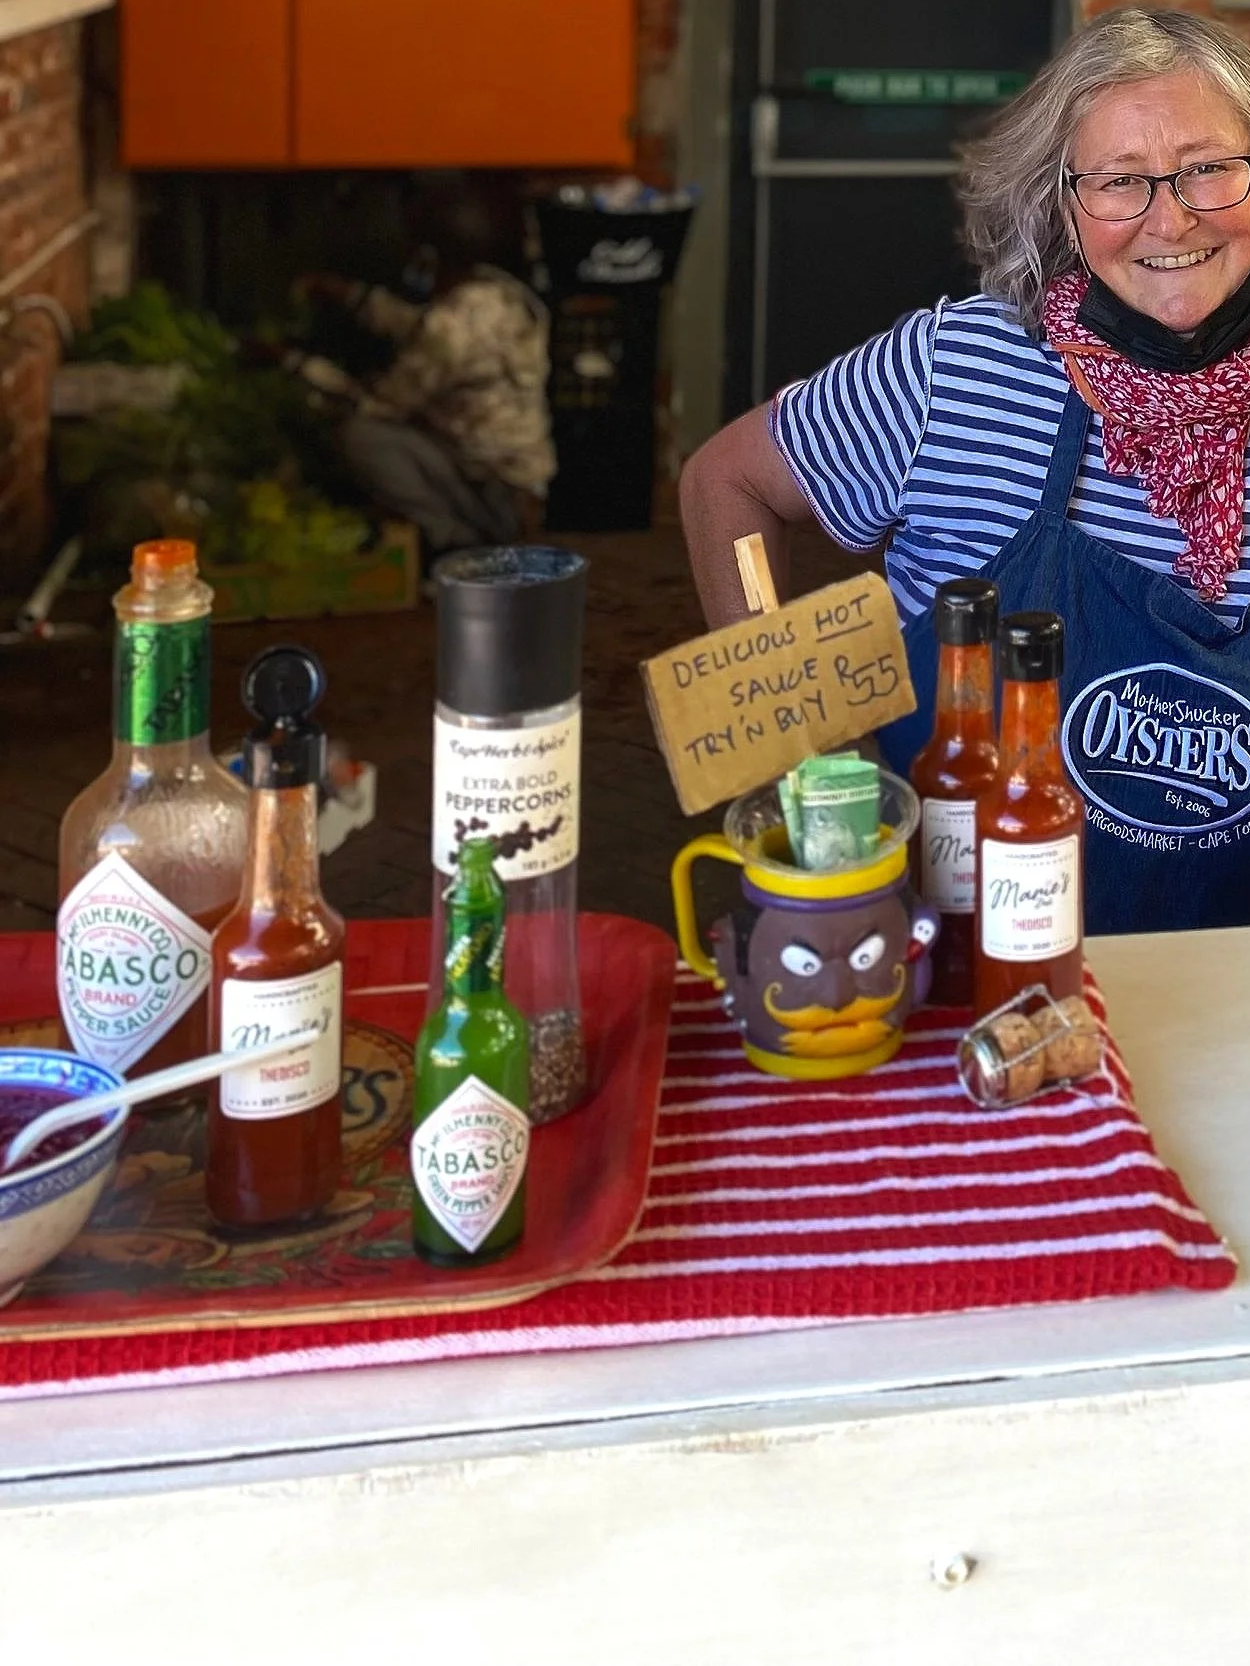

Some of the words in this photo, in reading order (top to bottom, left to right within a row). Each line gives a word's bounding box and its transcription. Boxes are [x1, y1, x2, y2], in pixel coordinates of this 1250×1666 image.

[672, 622, 796, 688] DELICIOUS
[815, 593, 870, 633] HOT
[730, 657, 818, 707] SAUCE
[834, 653, 899, 706] R55
[686, 725, 736, 765] TRY
[774, 690, 827, 733] BUY
[463, 776, 513, 792] EXTRA
[516, 770, 558, 791] BOLD
[446, 784, 572, 814] PEPPERCORNS
[1165, 790, 1184, 810] Est.
[1186, 801, 1211, 818] 2006
[1199, 827, 1231, 850] CAPE
[84, 988, 137, 1007] BRAND
[113, 987, 171, 1035] SAUCE
[416, 1130, 526, 1175] TABASCO
[451, 1175, 496, 1191] BRAND
